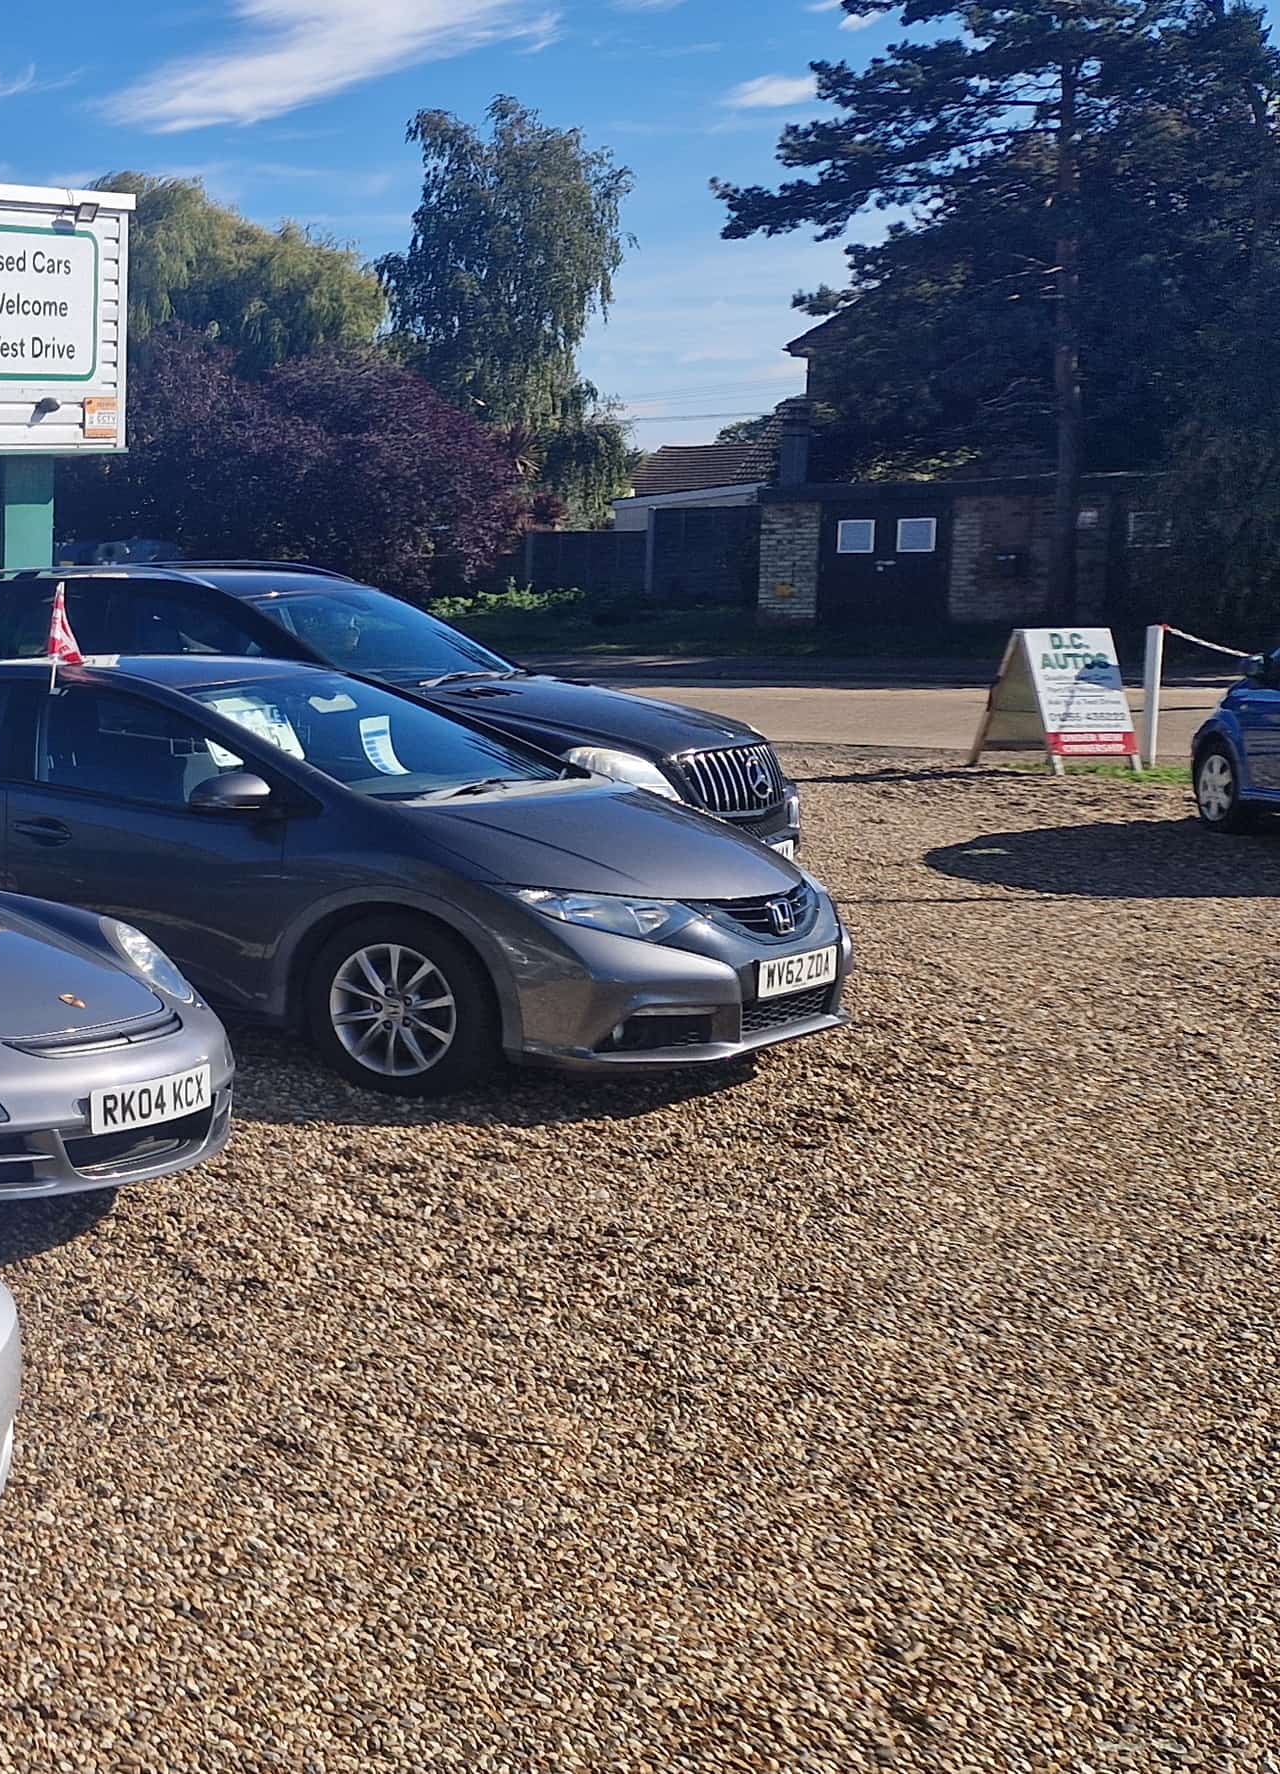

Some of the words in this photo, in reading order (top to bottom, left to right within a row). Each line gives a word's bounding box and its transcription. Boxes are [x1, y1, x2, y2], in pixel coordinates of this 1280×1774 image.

[32, 250, 72, 276] Cars
[32, 336, 75, 362] Drive
[1049, 633, 1090, 649] D.C.
[1041, 652, 1109, 669] AUTOS
[766, 957, 803, 989] WV62
[807, 951, 830, 979] ZDA
[102, 1084, 166, 1127] RK04
[172, 1071, 204, 1112] KCX
